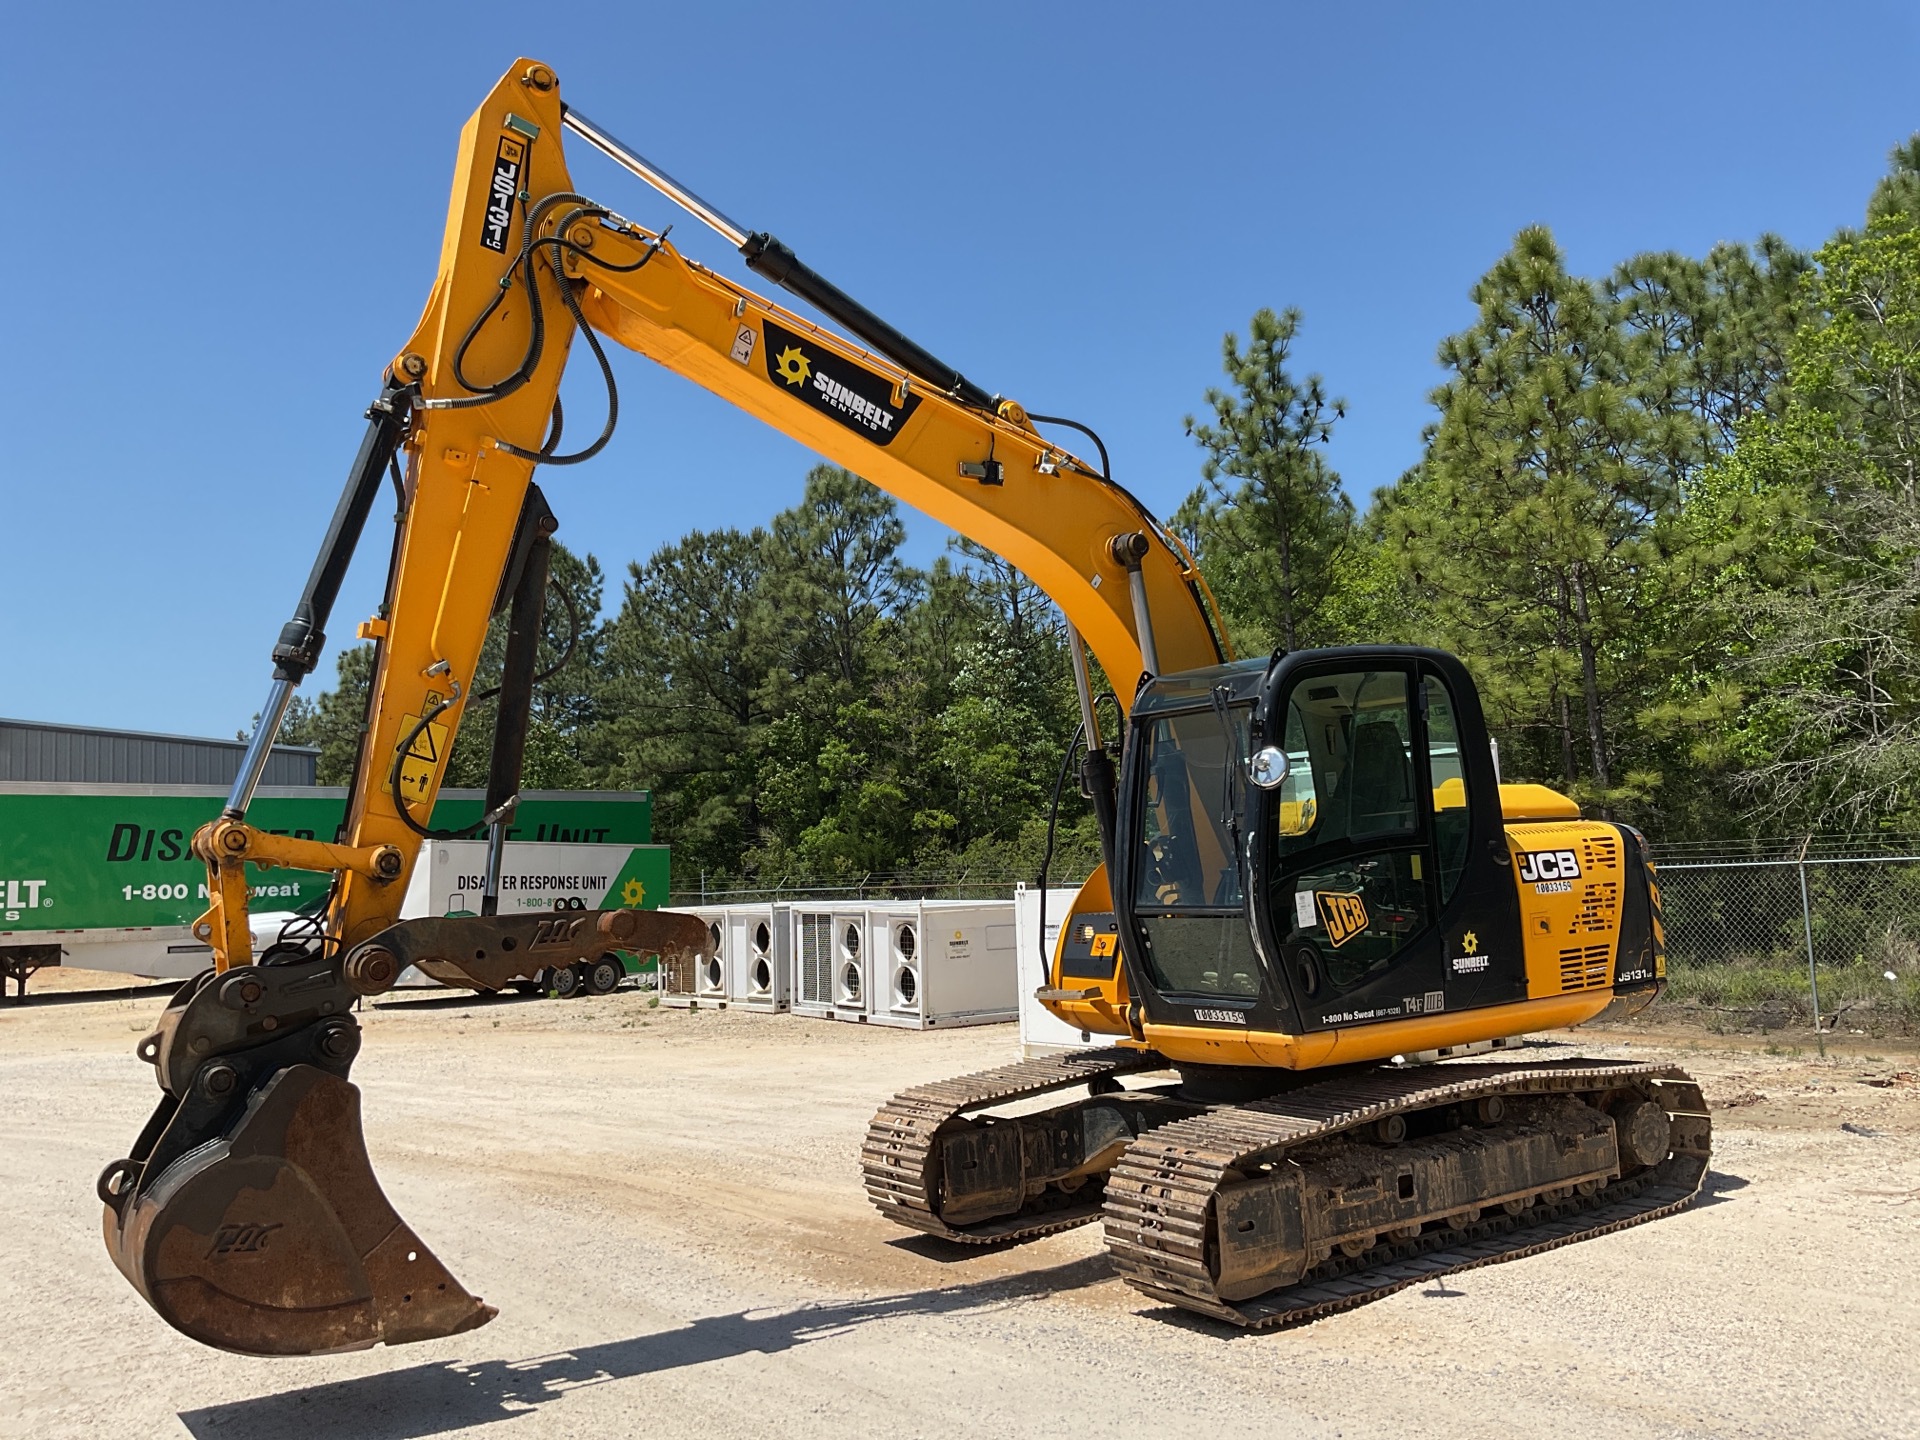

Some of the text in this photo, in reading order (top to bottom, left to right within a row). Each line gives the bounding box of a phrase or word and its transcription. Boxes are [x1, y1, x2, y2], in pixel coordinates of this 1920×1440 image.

[486, 164, 516, 249] JS131 LC
[813, 371, 894, 431] SUNBELT
[821, 393, 878, 431] RENTALS
[1521, 851, 1579, 880] JCB
[520, 875, 579, 890] RESPONSE
[582, 876, 608, 890] UNIT
[1536, 882, 1572, 893] 10033159
[122, 884, 189, 900] 1-800
[246, 883, 301, 897] weat
[1325, 897, 1366, 940] JCB
[1452, 955, 1489, 970] SUNBELT
[1618, 969, 1647, 982] JS131
[1402, 996, 1423, 1013] T4F
[1321, 1013, 1342, 1024] 1-800
[1343, 1011, 1353, 1021] No
[1353, 1010, 1375, 1020] Sweat
